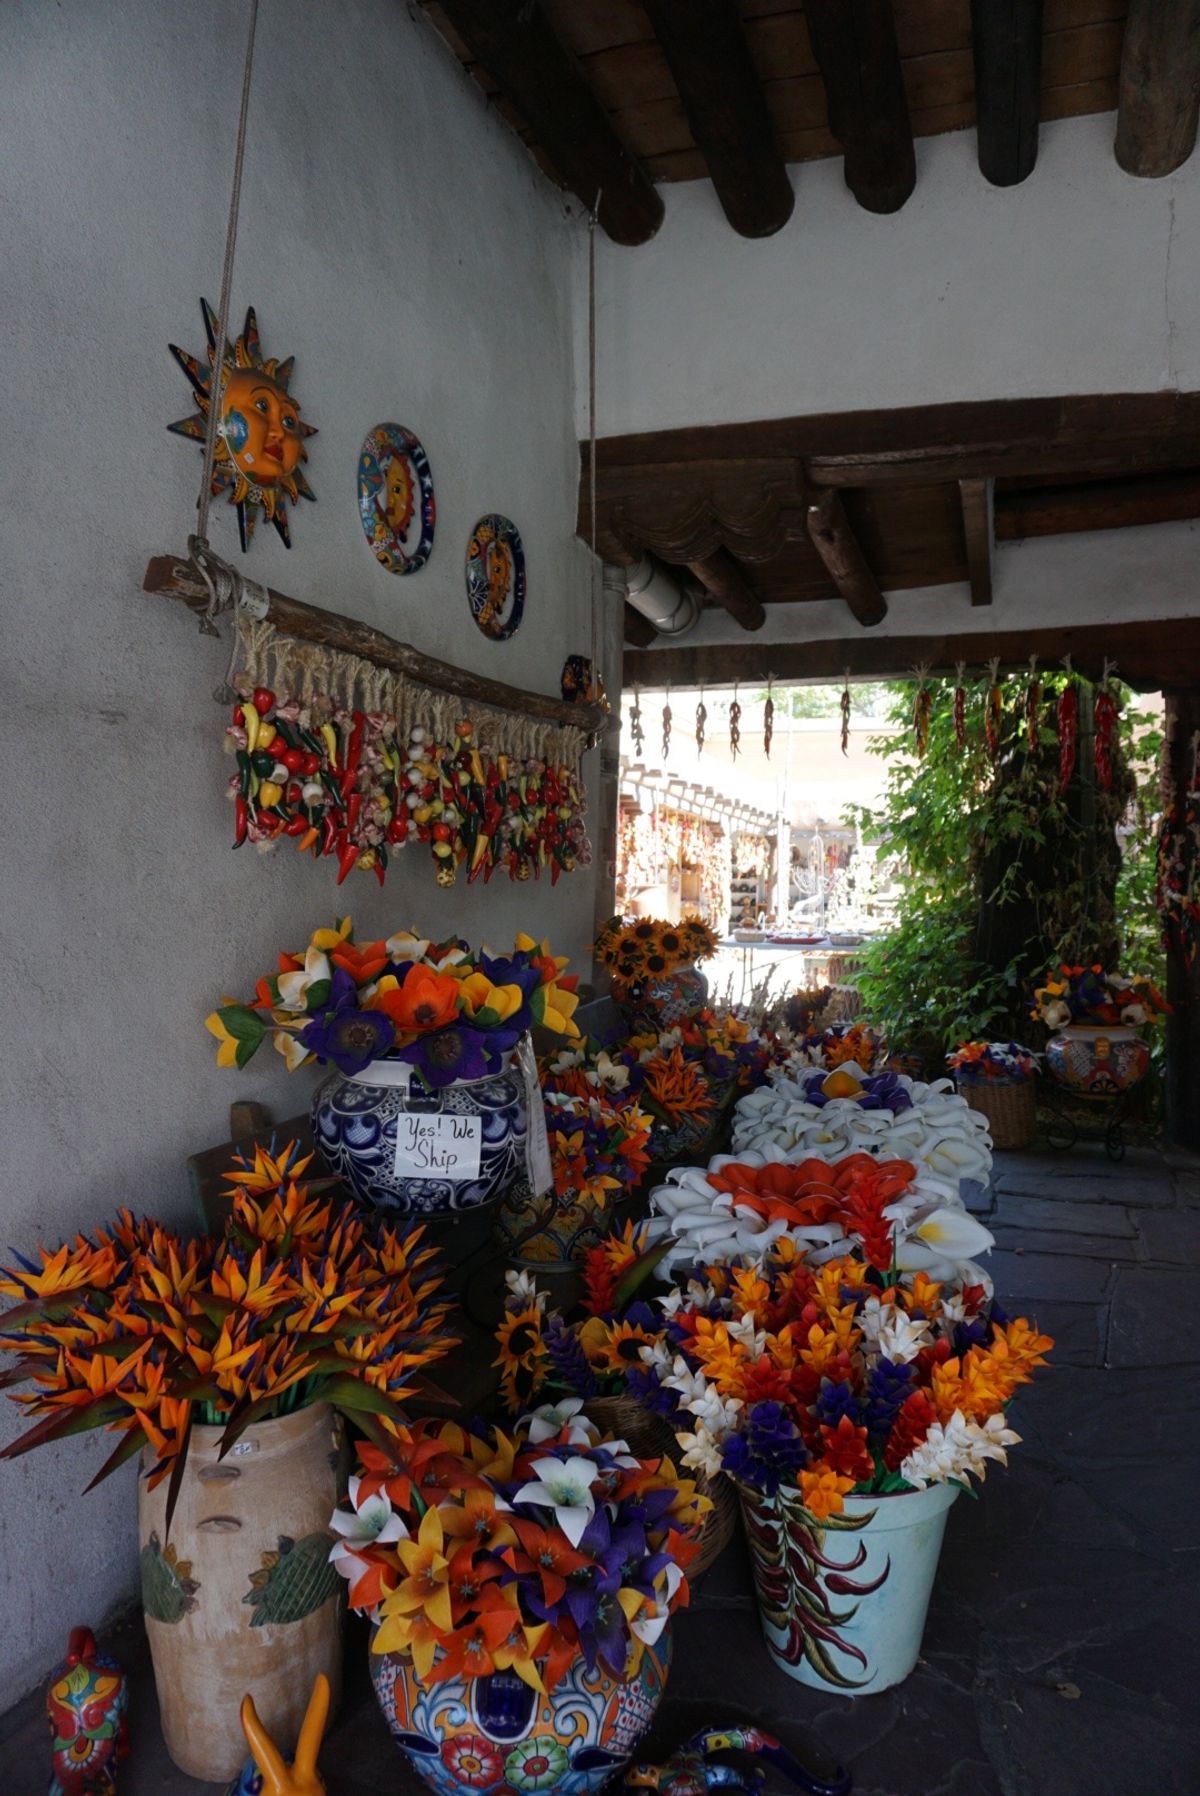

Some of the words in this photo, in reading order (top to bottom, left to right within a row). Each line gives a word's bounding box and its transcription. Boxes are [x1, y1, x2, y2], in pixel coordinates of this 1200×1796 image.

[405, 1117, 441, 1151] Yes!
[450, 1118, 475, 1139] We
[414, 1138, 458, 1174] Ship
